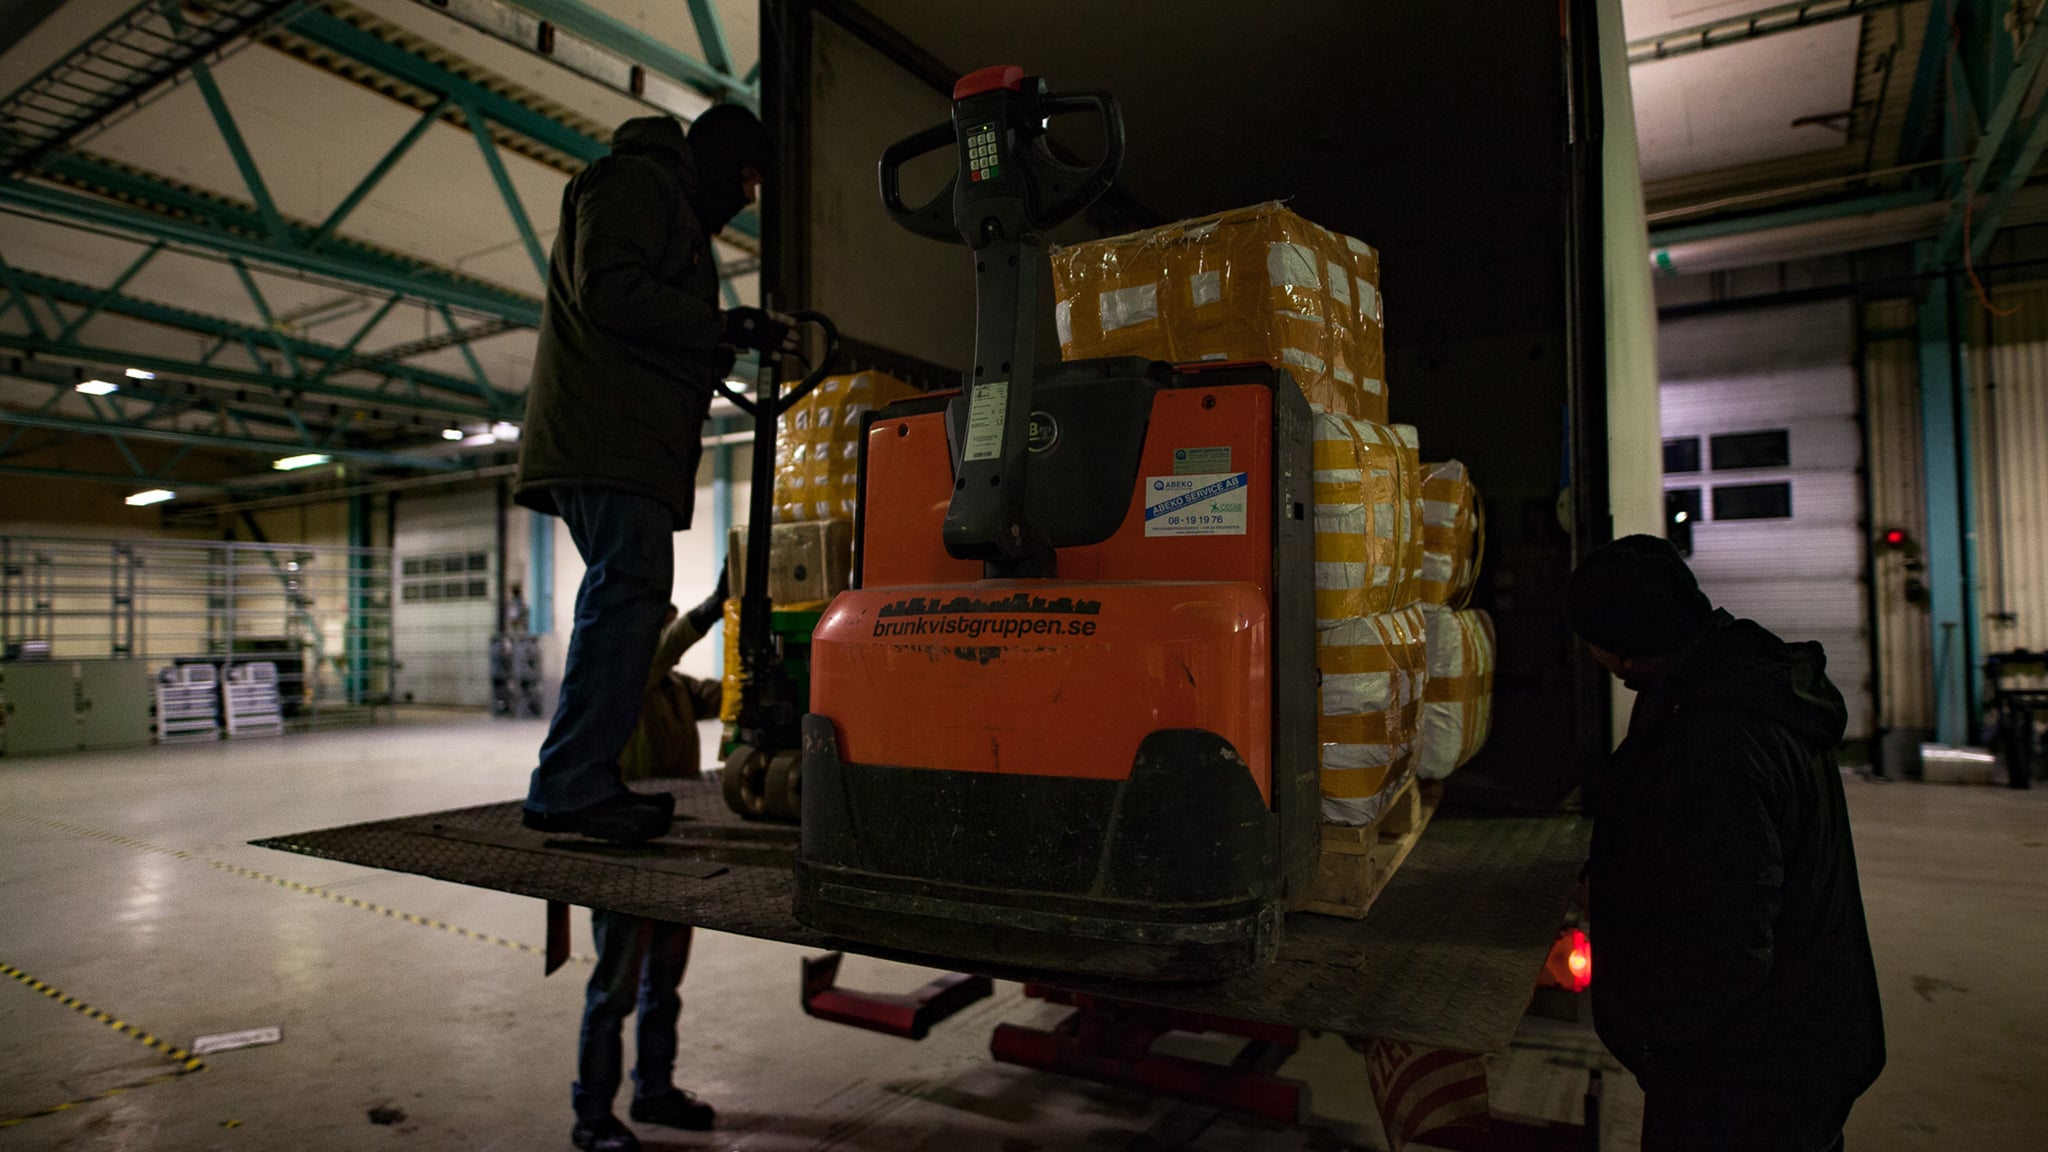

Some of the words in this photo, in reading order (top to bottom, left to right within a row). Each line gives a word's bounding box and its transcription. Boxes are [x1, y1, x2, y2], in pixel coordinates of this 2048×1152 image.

[1165, 480, 1193, 488] ABEKO
[1153, 496, 1184, 515] ABEKO
[1184, 483, 1224, 502] SERVICE
[1225, 477, 1240, 488] AB
[1211, 515, 1223, 524] 76
[873, 616, 1097, 638] brunkvistgruppen.se
